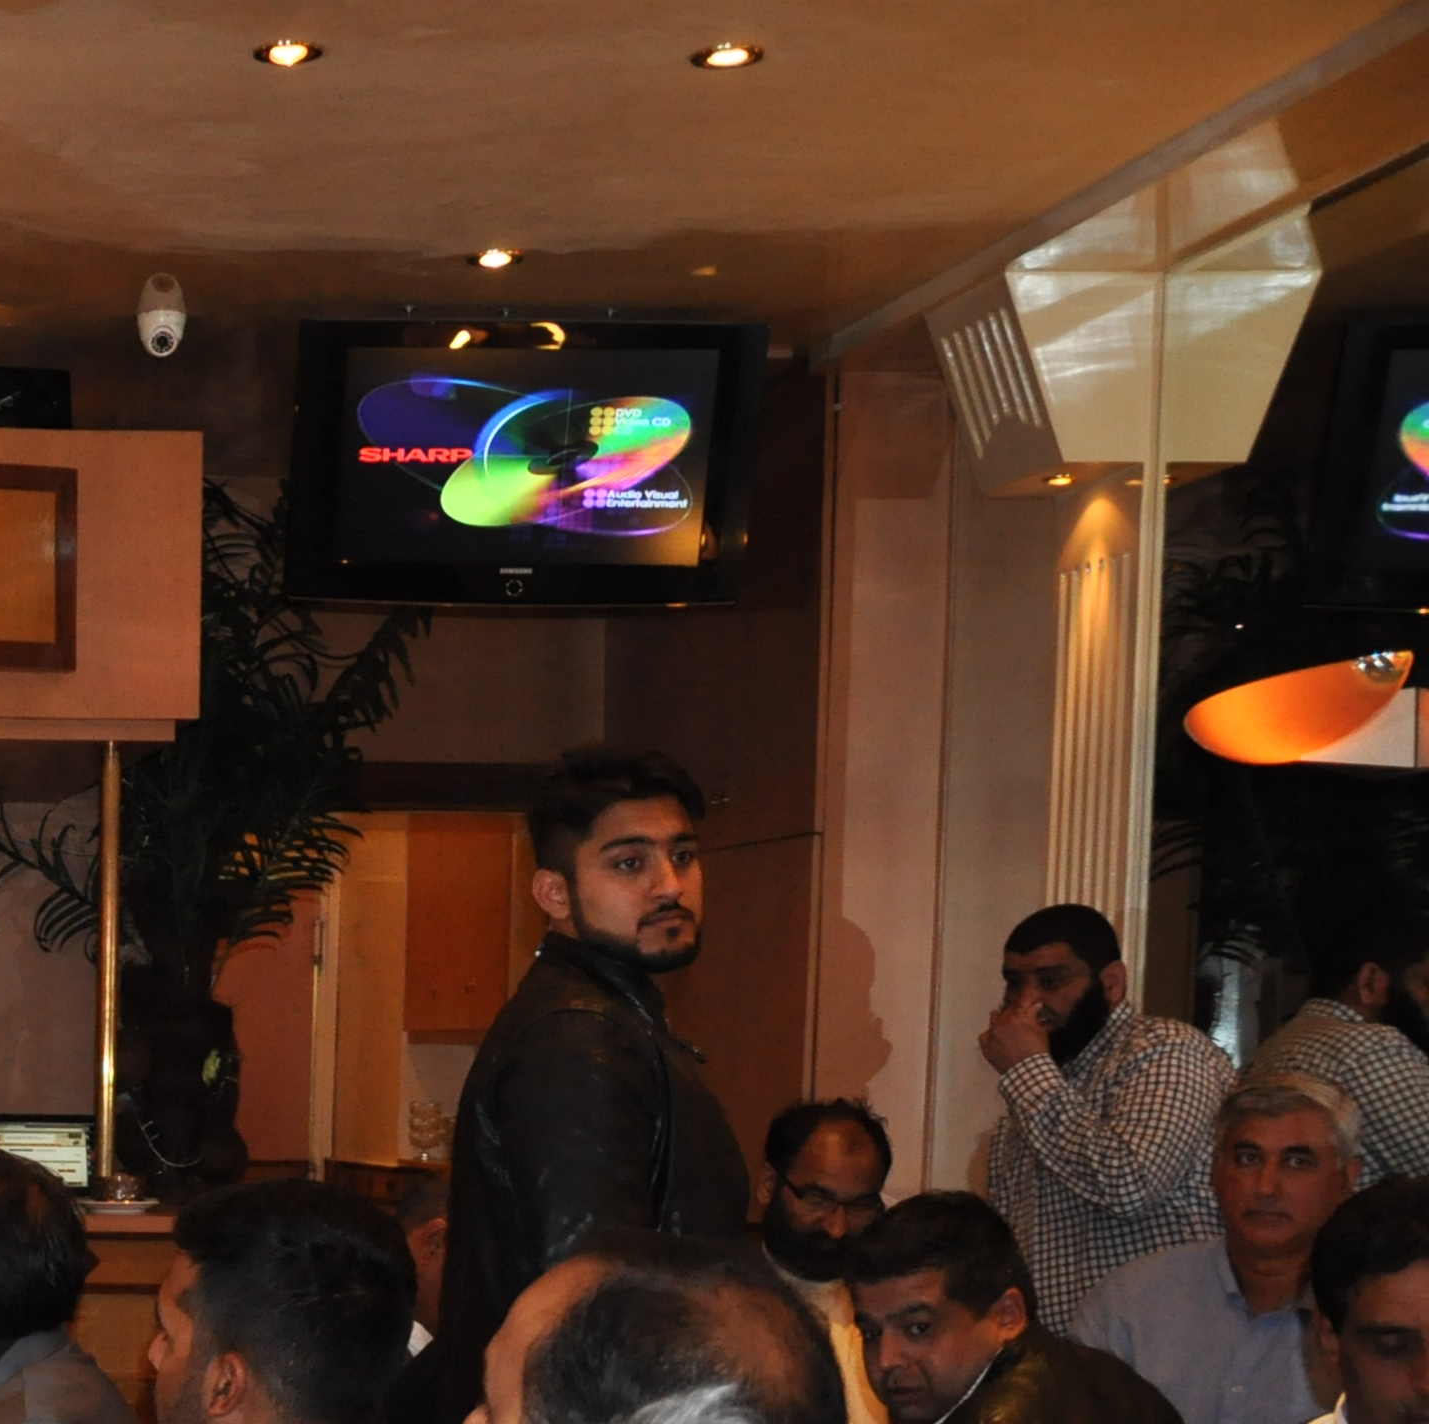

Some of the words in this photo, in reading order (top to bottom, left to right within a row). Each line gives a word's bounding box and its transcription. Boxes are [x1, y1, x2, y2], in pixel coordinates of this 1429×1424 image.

[616, 408, 642, 418] DVD
[651, 417, 672, 427] CD
[358, 446, 473, 463] SHARP
[607, 490, 642, 499] Audio
[644, 490, 679, 500] Visual
[606, 499, 688, 508] Entertainment
